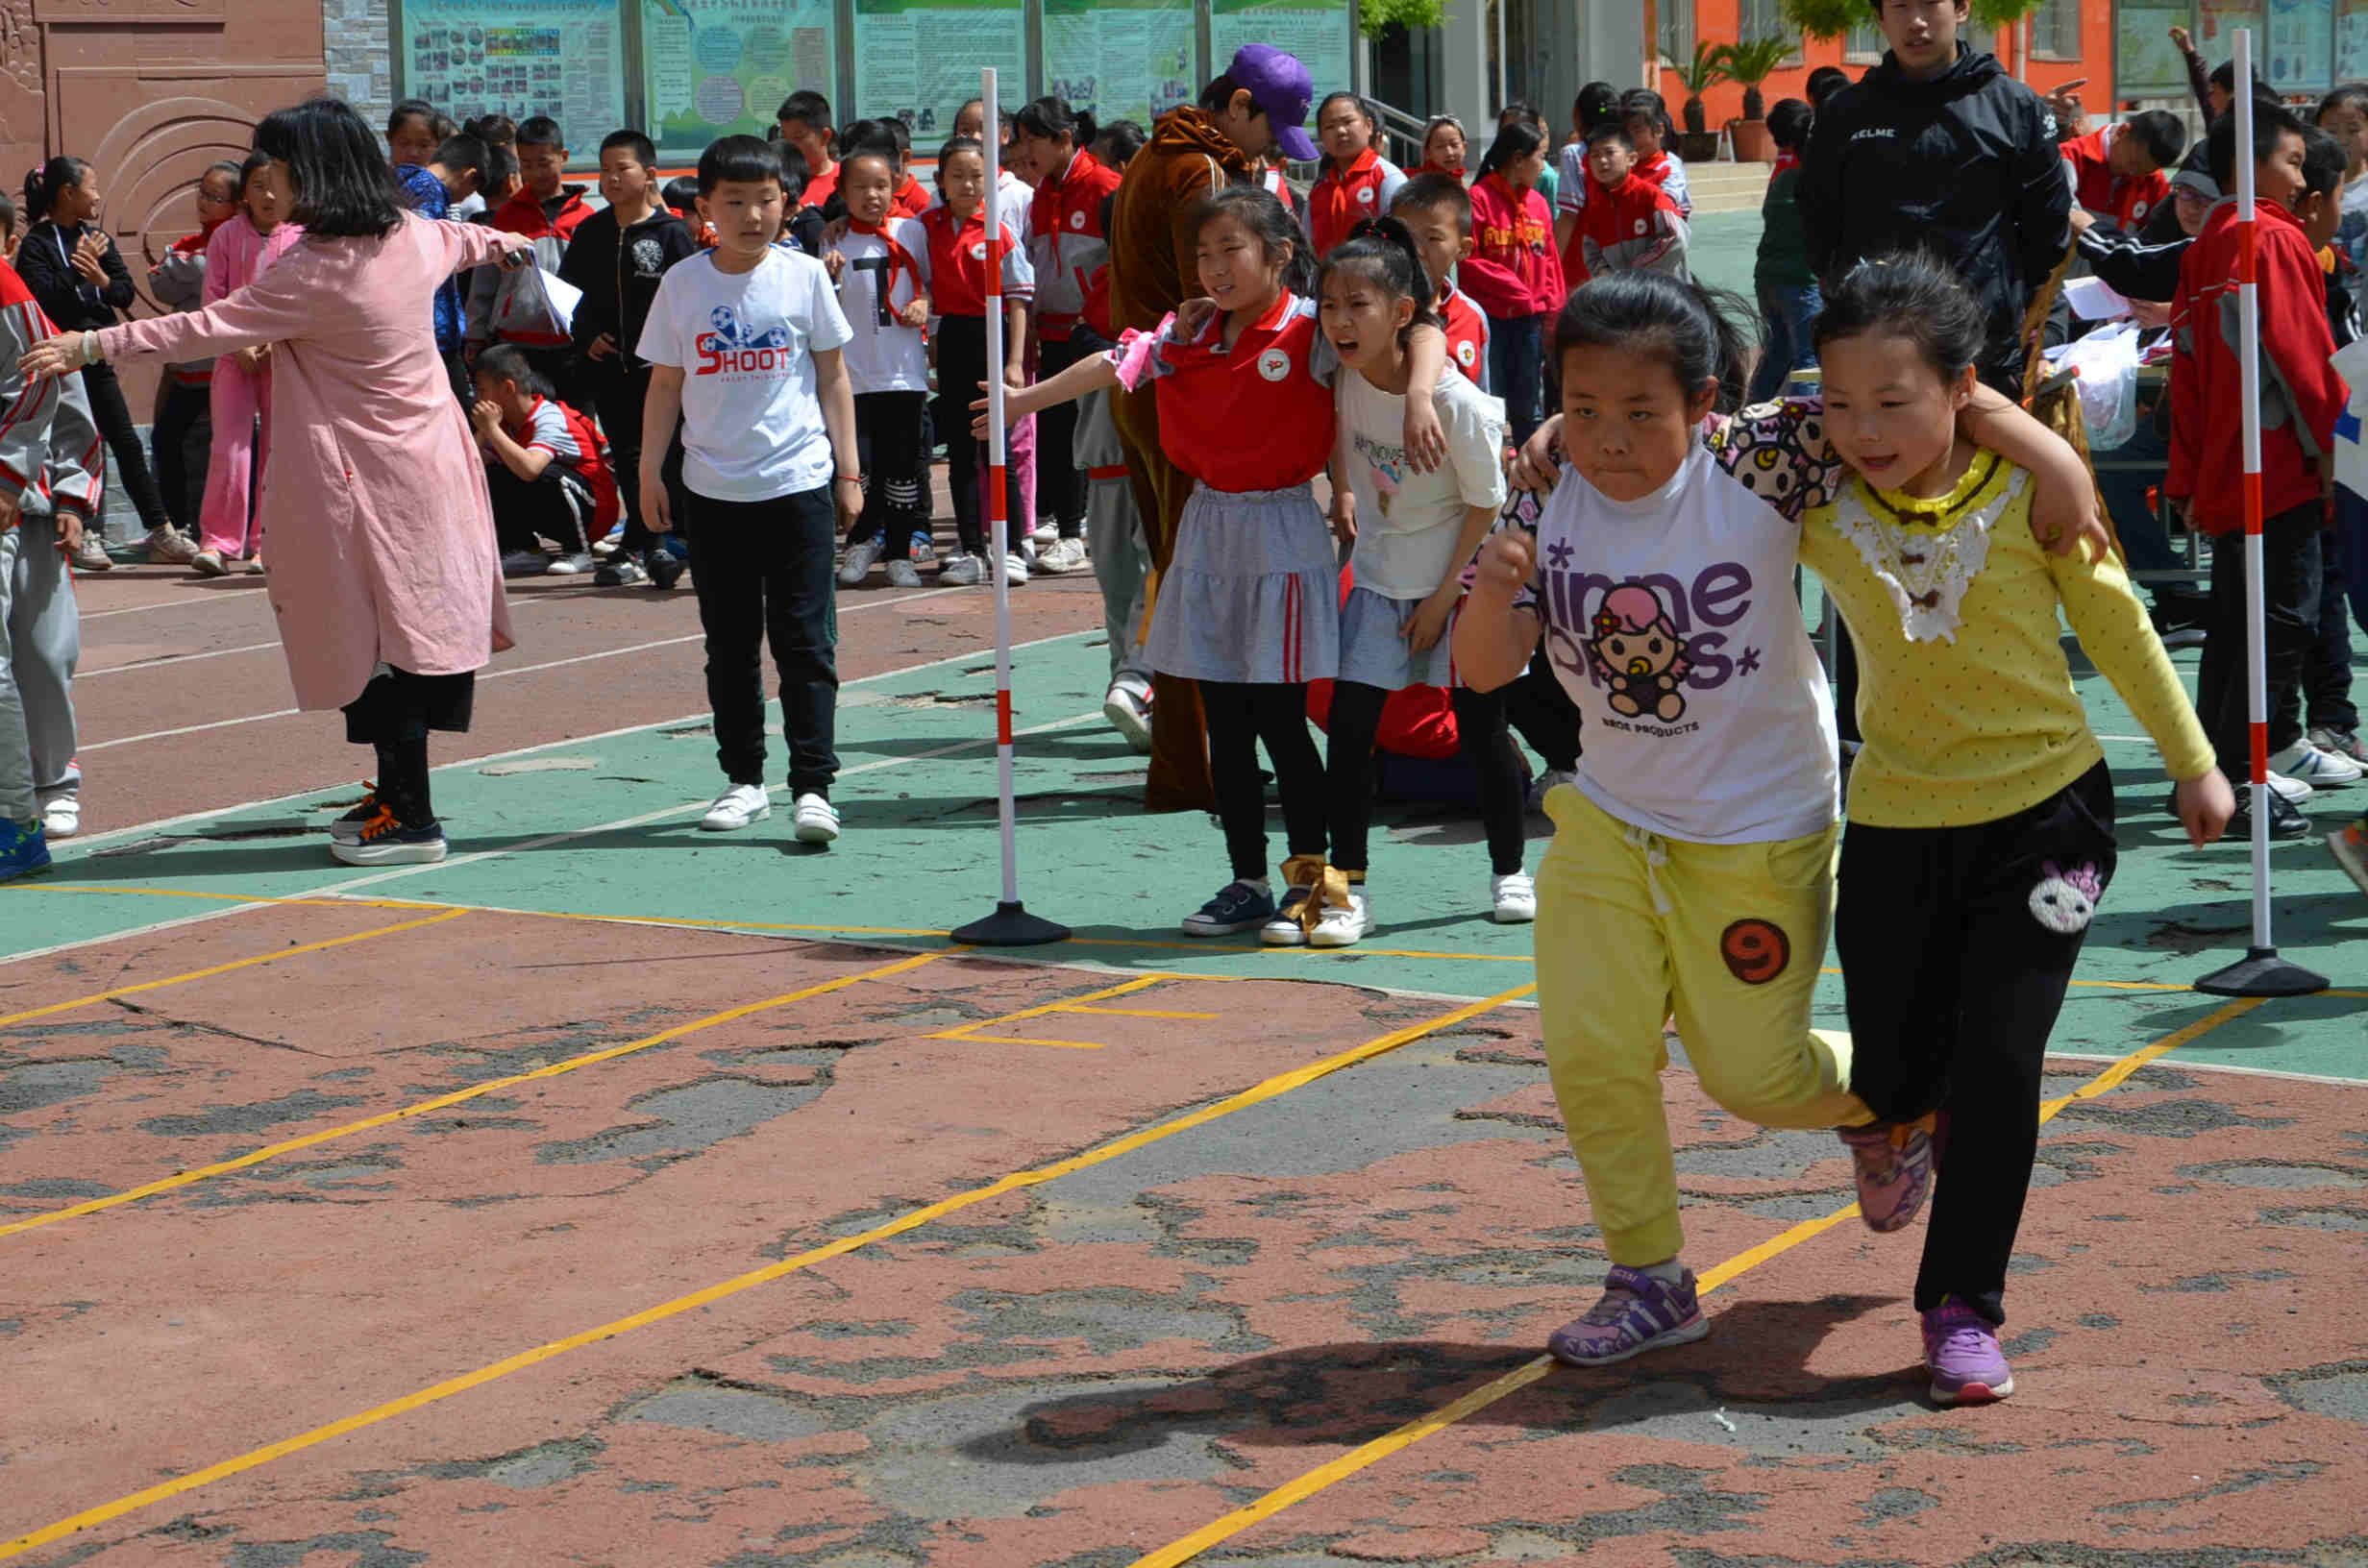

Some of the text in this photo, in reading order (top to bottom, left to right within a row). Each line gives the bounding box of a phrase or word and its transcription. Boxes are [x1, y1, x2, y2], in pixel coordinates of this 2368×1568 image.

[1850, 128, 1895, 140] KELME
[695, 332, 790, 376] SHOOT
[1635, 722, 1699, 738] PRODUCTS
[1729, 923, 1781, 980] 9
